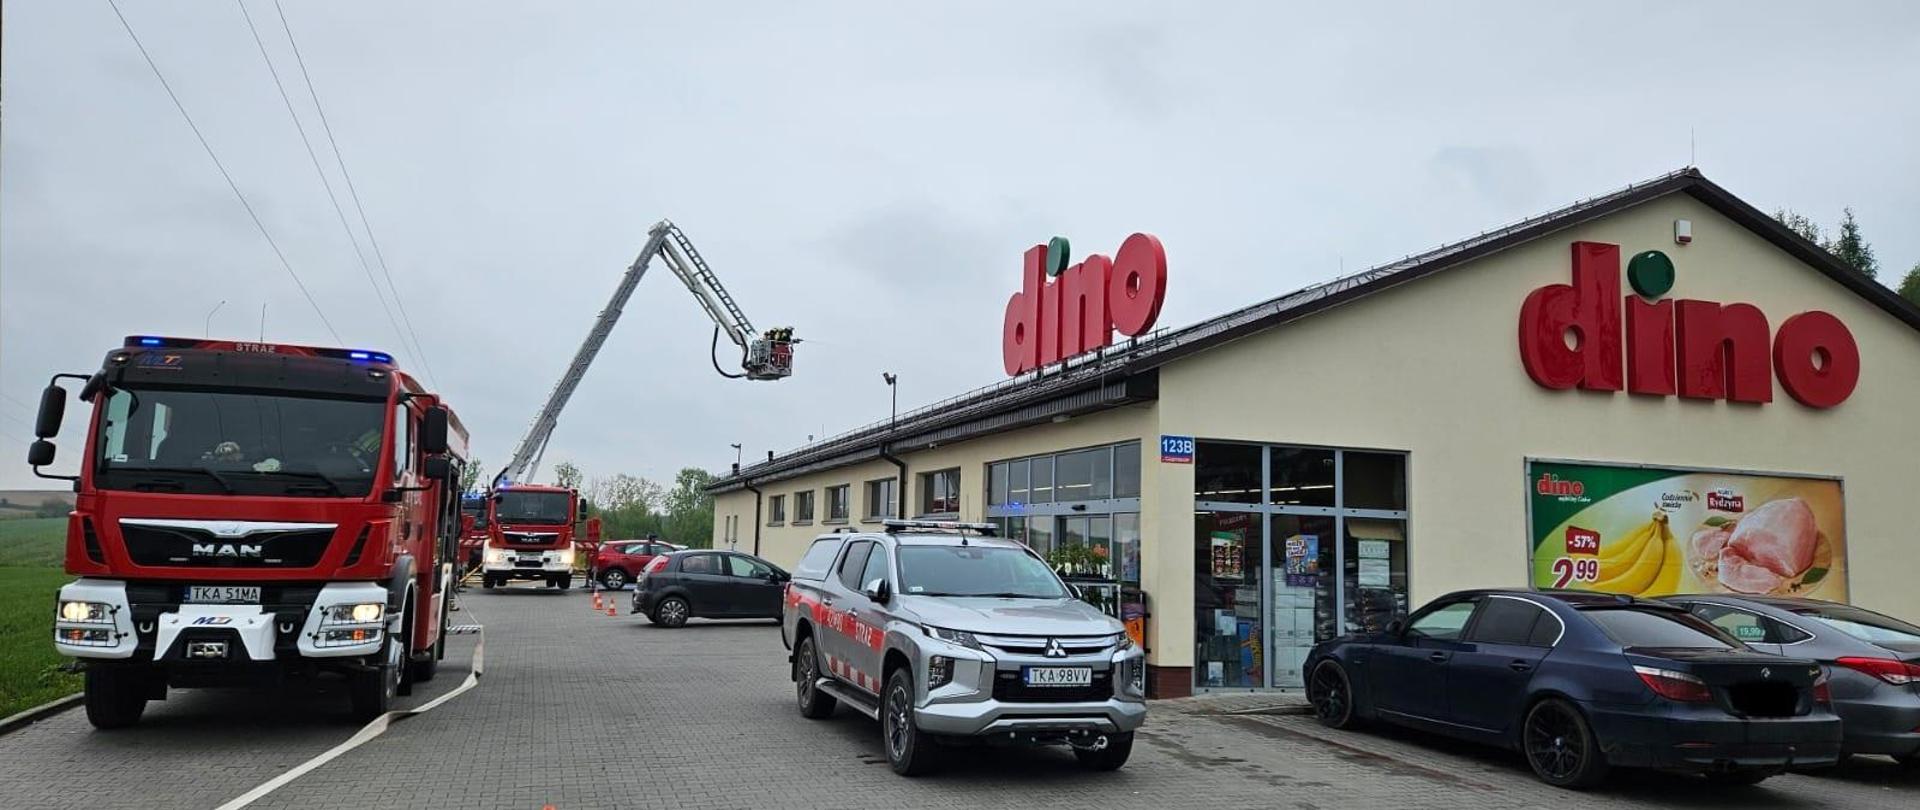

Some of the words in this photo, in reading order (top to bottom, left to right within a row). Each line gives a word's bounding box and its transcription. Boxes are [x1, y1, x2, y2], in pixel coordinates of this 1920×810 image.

[1003, 232, 1167, 376] dino
[1519, 241, 1860, 408] dino
[1162, 438, 1192, 453] 123B
[1537, 473, 1584, 496] dino
[1709, 496, 1742, 510] Rydzyna
[1568, 535, 1597, 549] -57%
[192, 544, 262, 557] MAN
[193, 588, 221, 600] TKA
[225, 588, 258, 600] 51MA
[1032, 669, 1055, 682] TKA
[1059, 669, 1088, 682] 98VV
